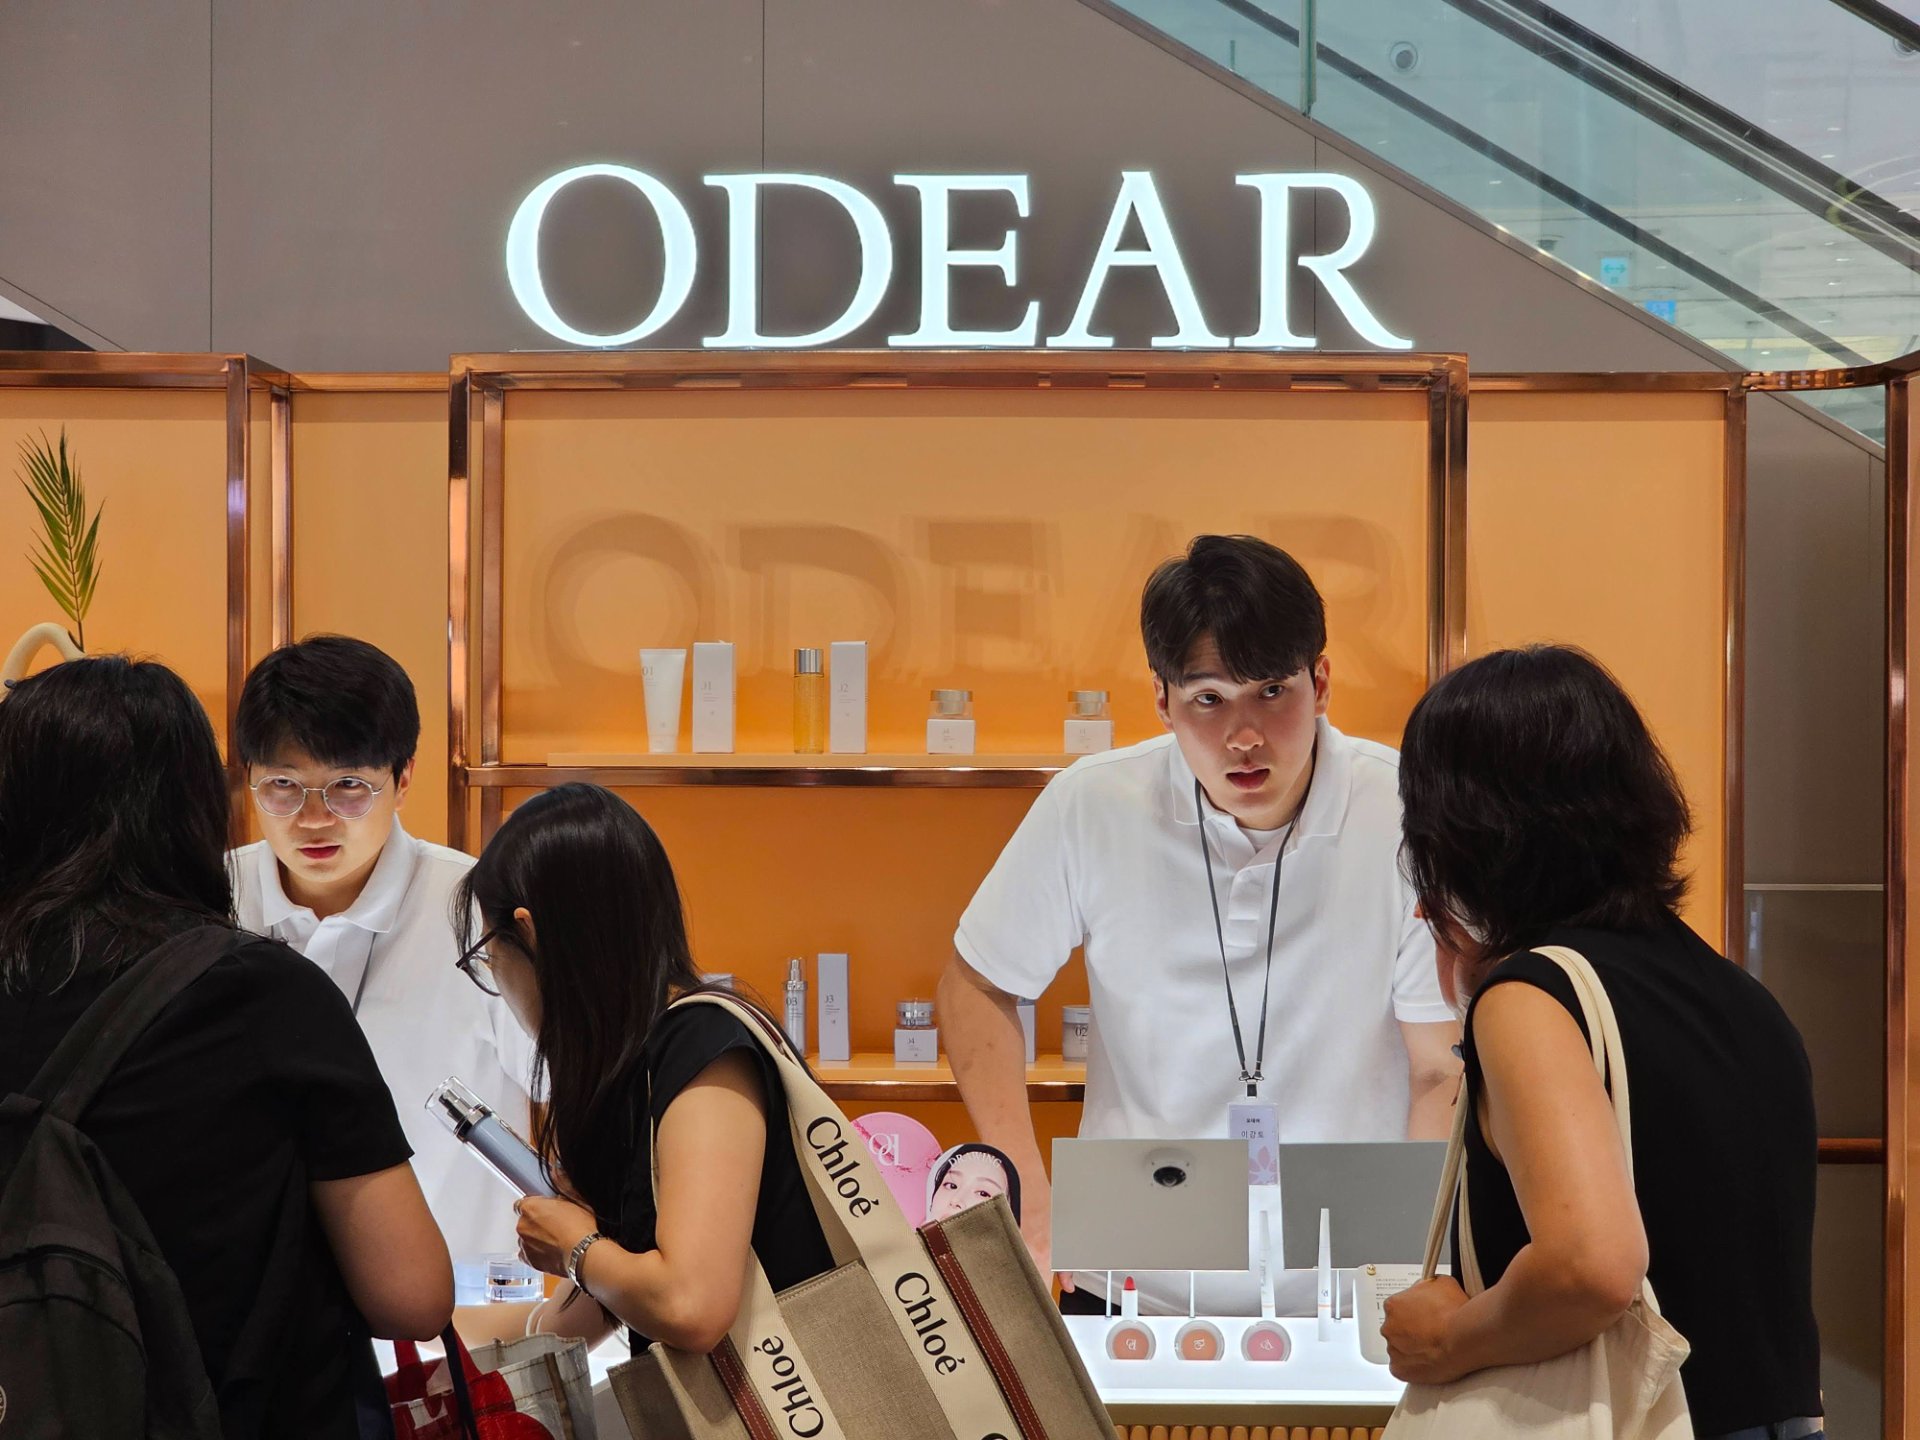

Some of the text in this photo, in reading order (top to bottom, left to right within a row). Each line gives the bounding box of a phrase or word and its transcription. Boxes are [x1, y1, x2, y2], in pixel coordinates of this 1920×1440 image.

[506, 163, 1414, 350] ODEAR
[805, 1115, 880, 1219] Chloé
[893, 1271, 966, 1376] Chloé
[752, 1334, 825, 1440] Chloé
